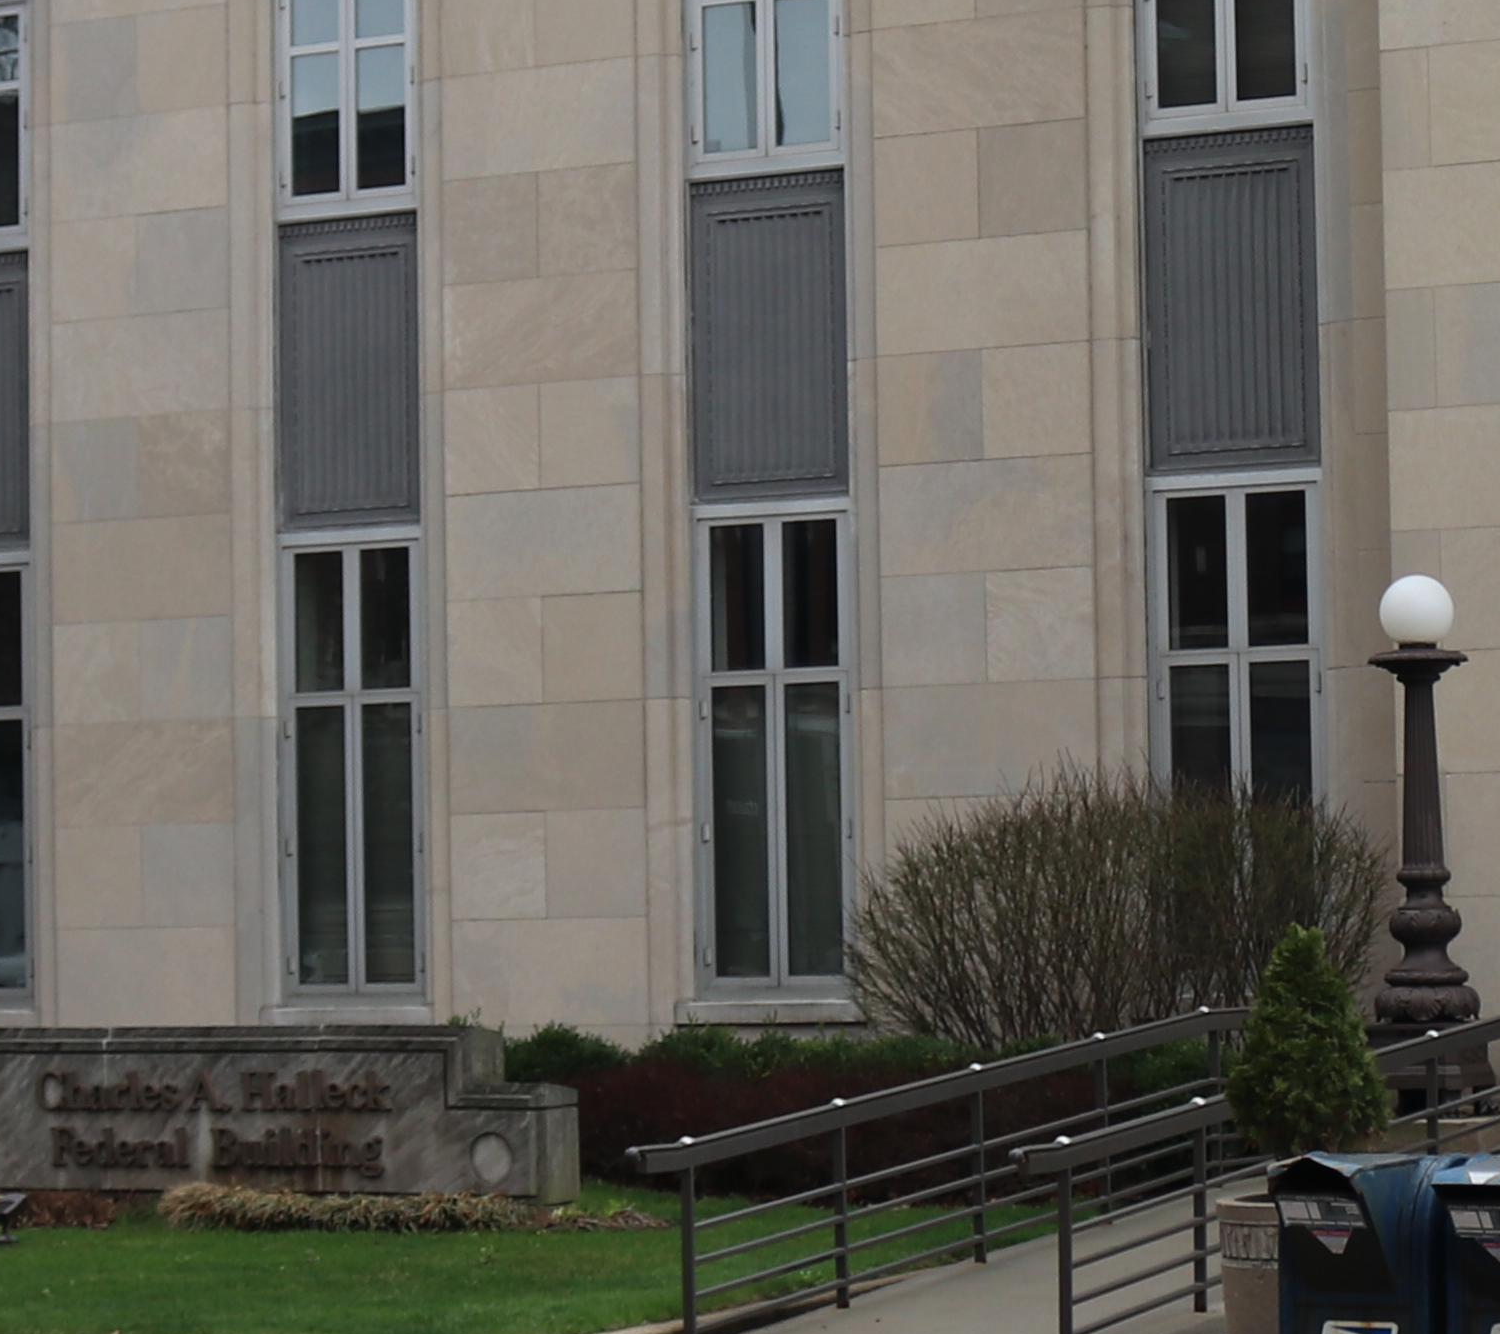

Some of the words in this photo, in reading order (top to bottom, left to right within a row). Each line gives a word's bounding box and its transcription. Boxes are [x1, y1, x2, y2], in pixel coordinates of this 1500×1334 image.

[37, 1071, 181, 1112] Charles
[190, 1071, 232, 1112] A.
[240, 1070, 393, 1112] Halleck
[51, 1127, 189, 1168] Federal
[211, 1127, 385, 1178] Building
